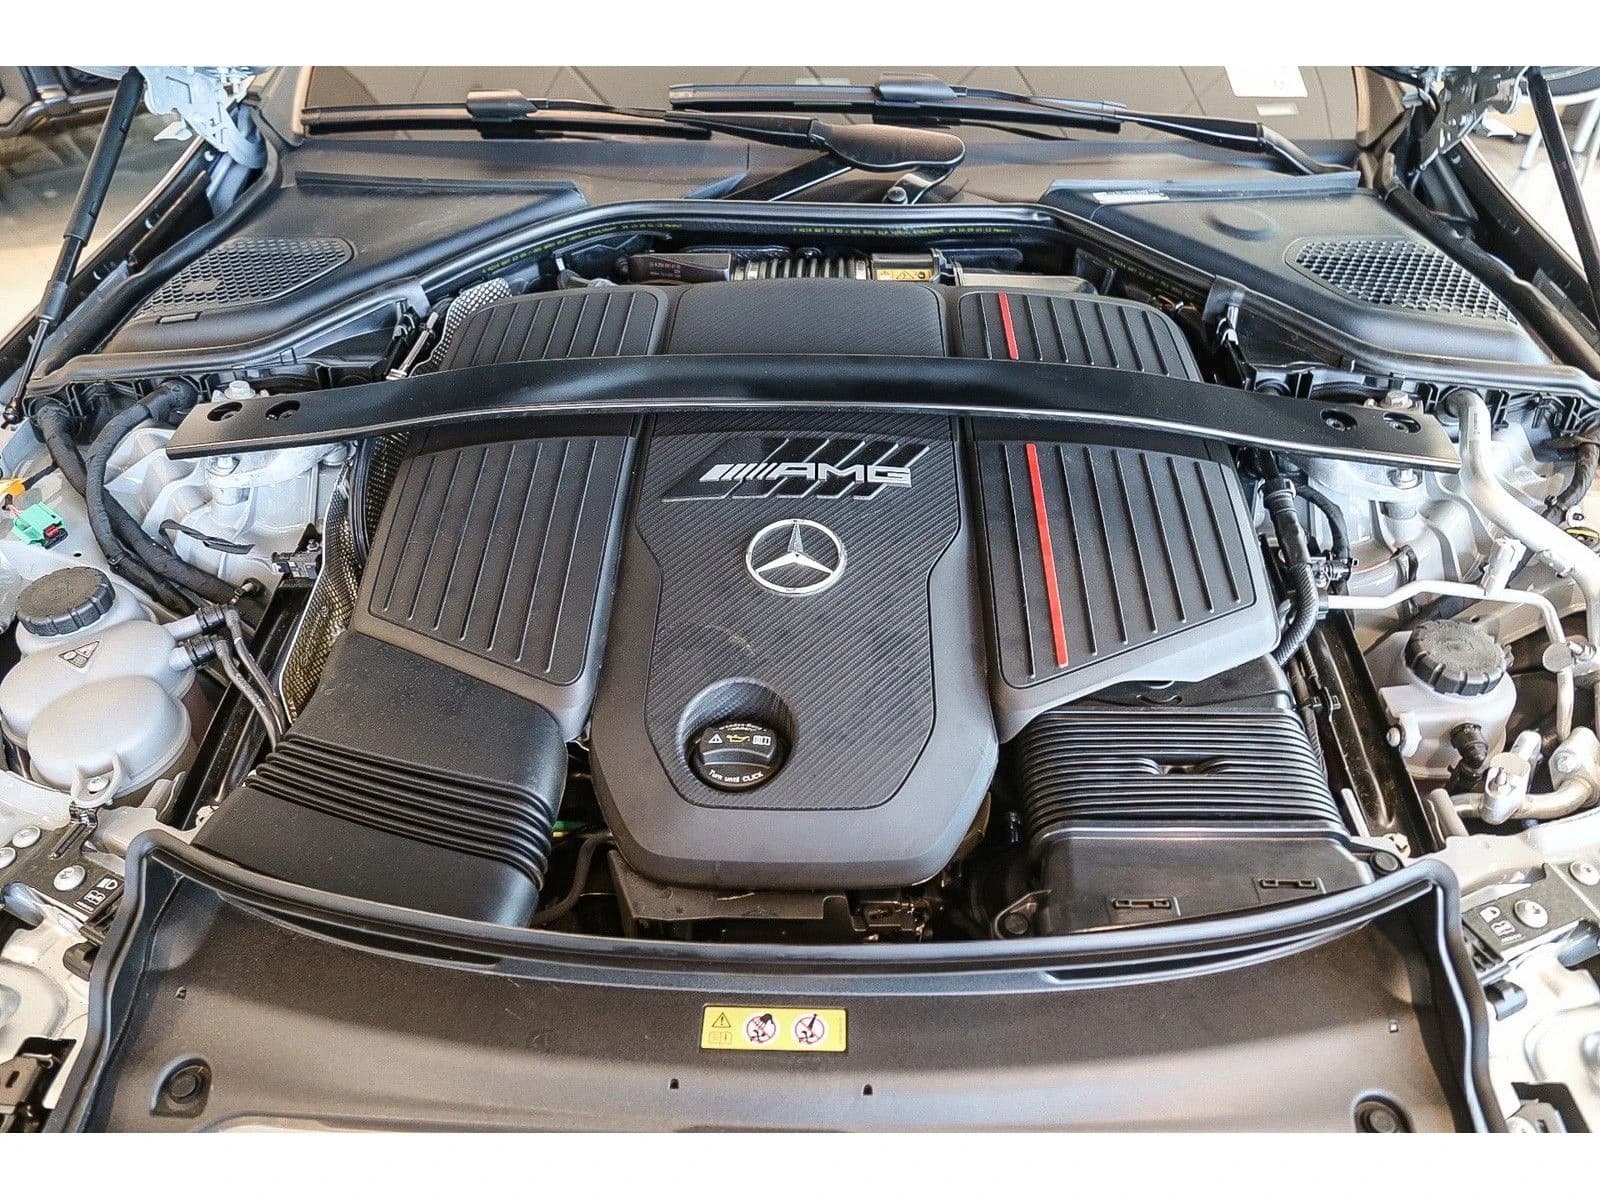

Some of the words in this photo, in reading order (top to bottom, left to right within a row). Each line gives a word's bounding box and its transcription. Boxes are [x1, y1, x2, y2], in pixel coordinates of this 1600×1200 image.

[766, 462, 912, 488] AMG
[708, 769, 723, 781] Turn
[742, 771, 764, 782] CLICK
